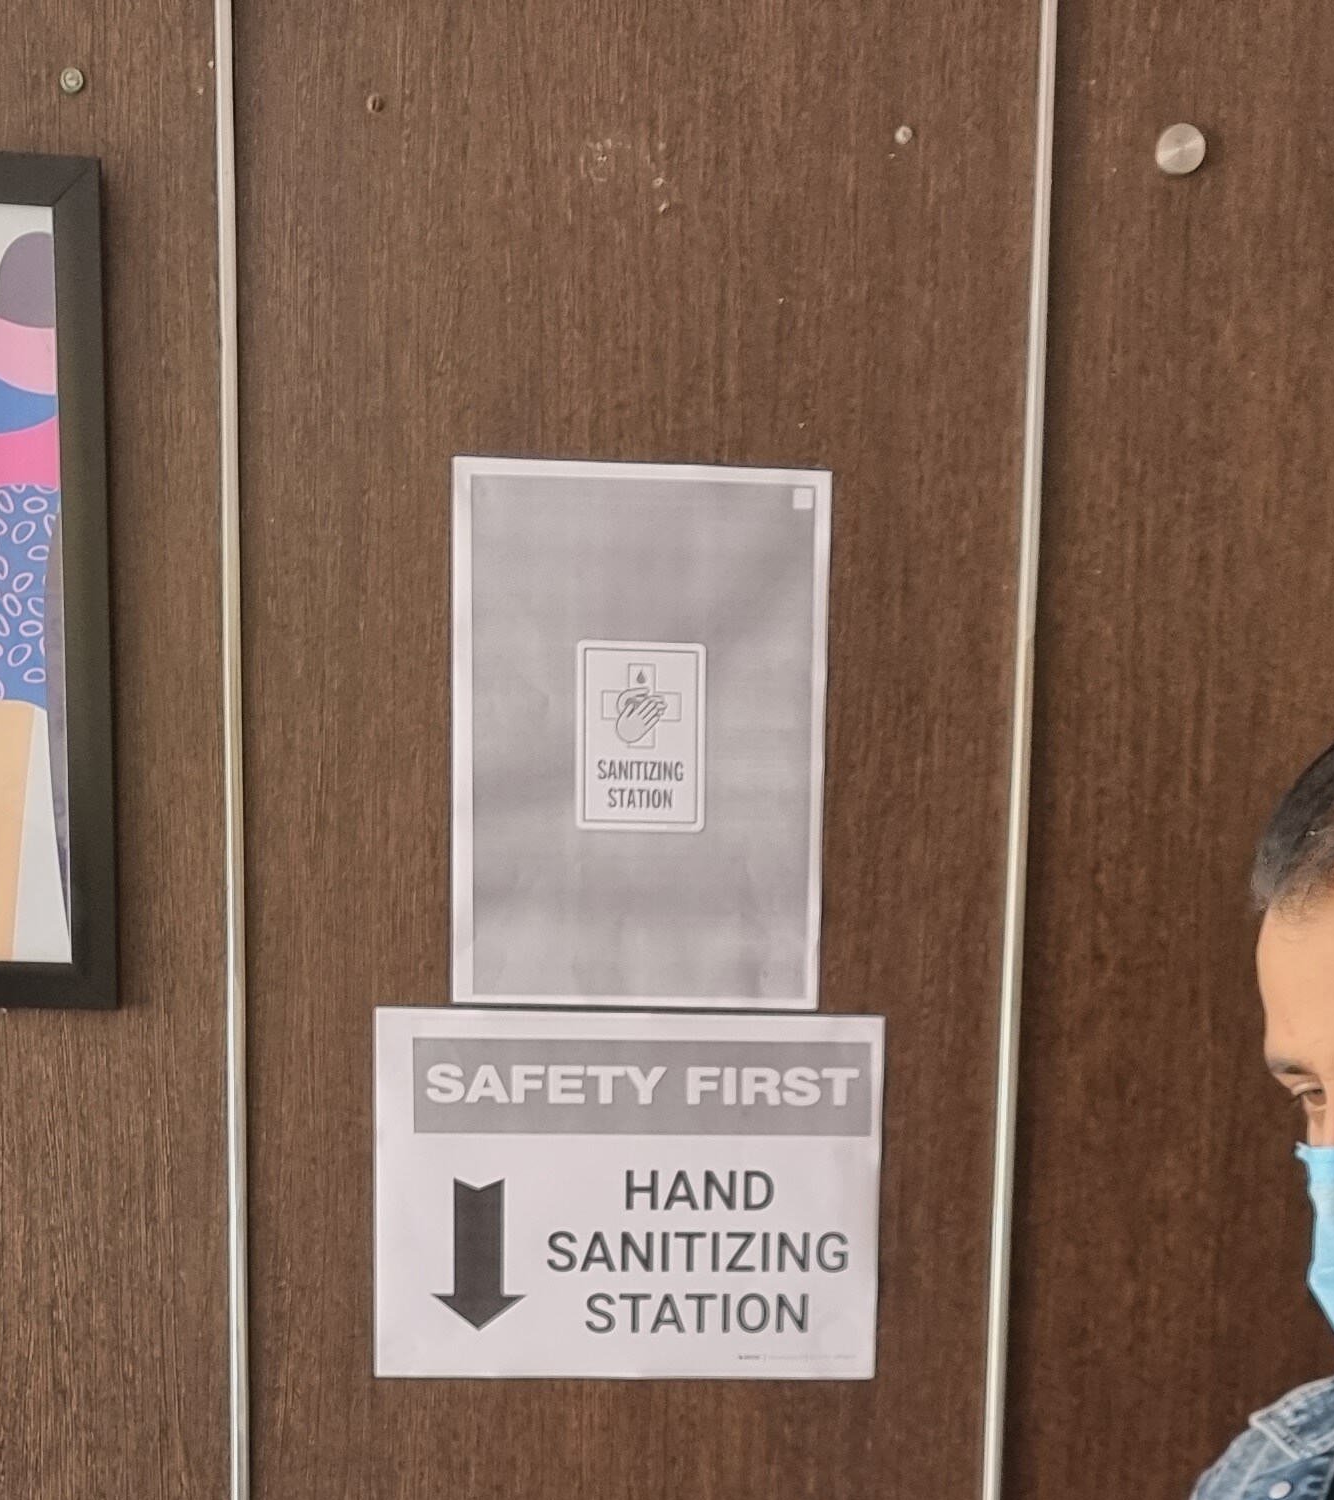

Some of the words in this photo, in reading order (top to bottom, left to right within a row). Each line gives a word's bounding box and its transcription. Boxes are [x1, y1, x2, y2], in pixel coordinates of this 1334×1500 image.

[597, 759, 685, 782] SANITIZING
[607, 787, 674, 809] STATION
[424, 1062, 667, 1105] SAFETY
[685, 1065, 861, 1107] FIRST
[624, 1168, 776, 1212] HAND
[546, 1230, 851, 1273] SANITIZING
[584, 1292, 810, 1335] STATION
